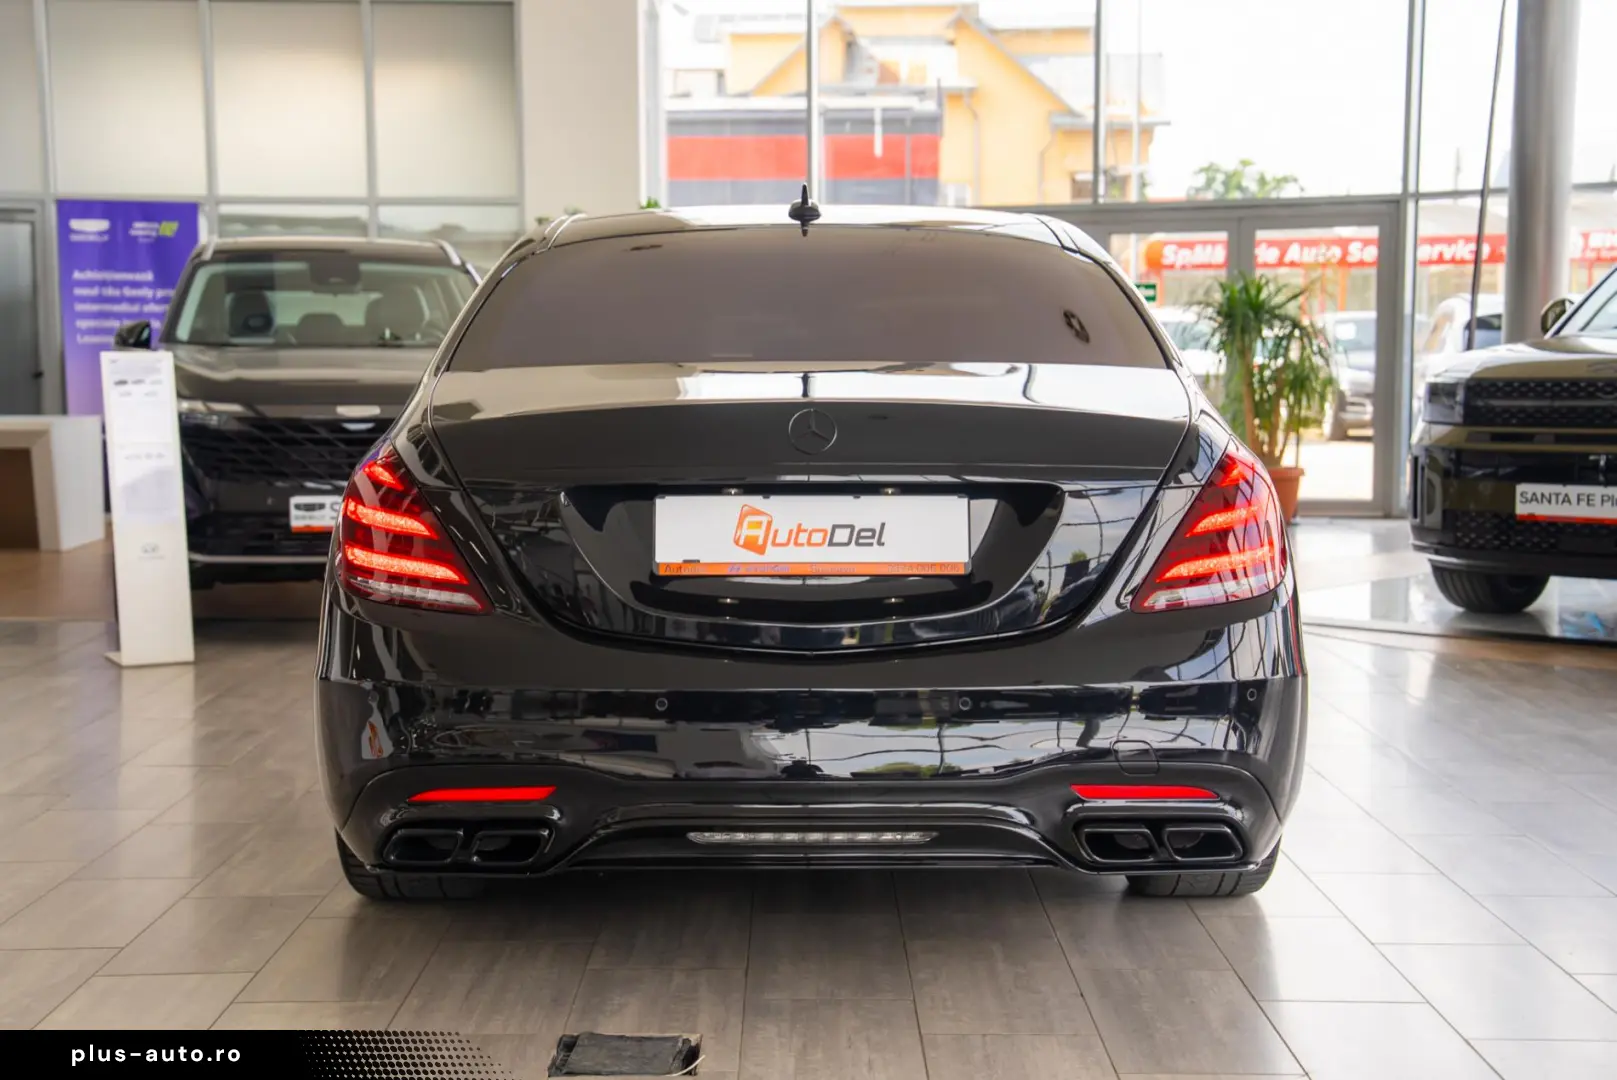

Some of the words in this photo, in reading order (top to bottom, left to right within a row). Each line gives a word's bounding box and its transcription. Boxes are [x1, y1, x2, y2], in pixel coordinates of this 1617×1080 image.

[1283, 242, 1342, 264] Auto
[1345, 241, 1379, 263] Se
[1417, 239, 1491, 262] ervice
[1519, 490, 1572, 506] SANTA
[1577, 493, 1596, 507] FE
[736, 507, 886, 551] AutoDel
